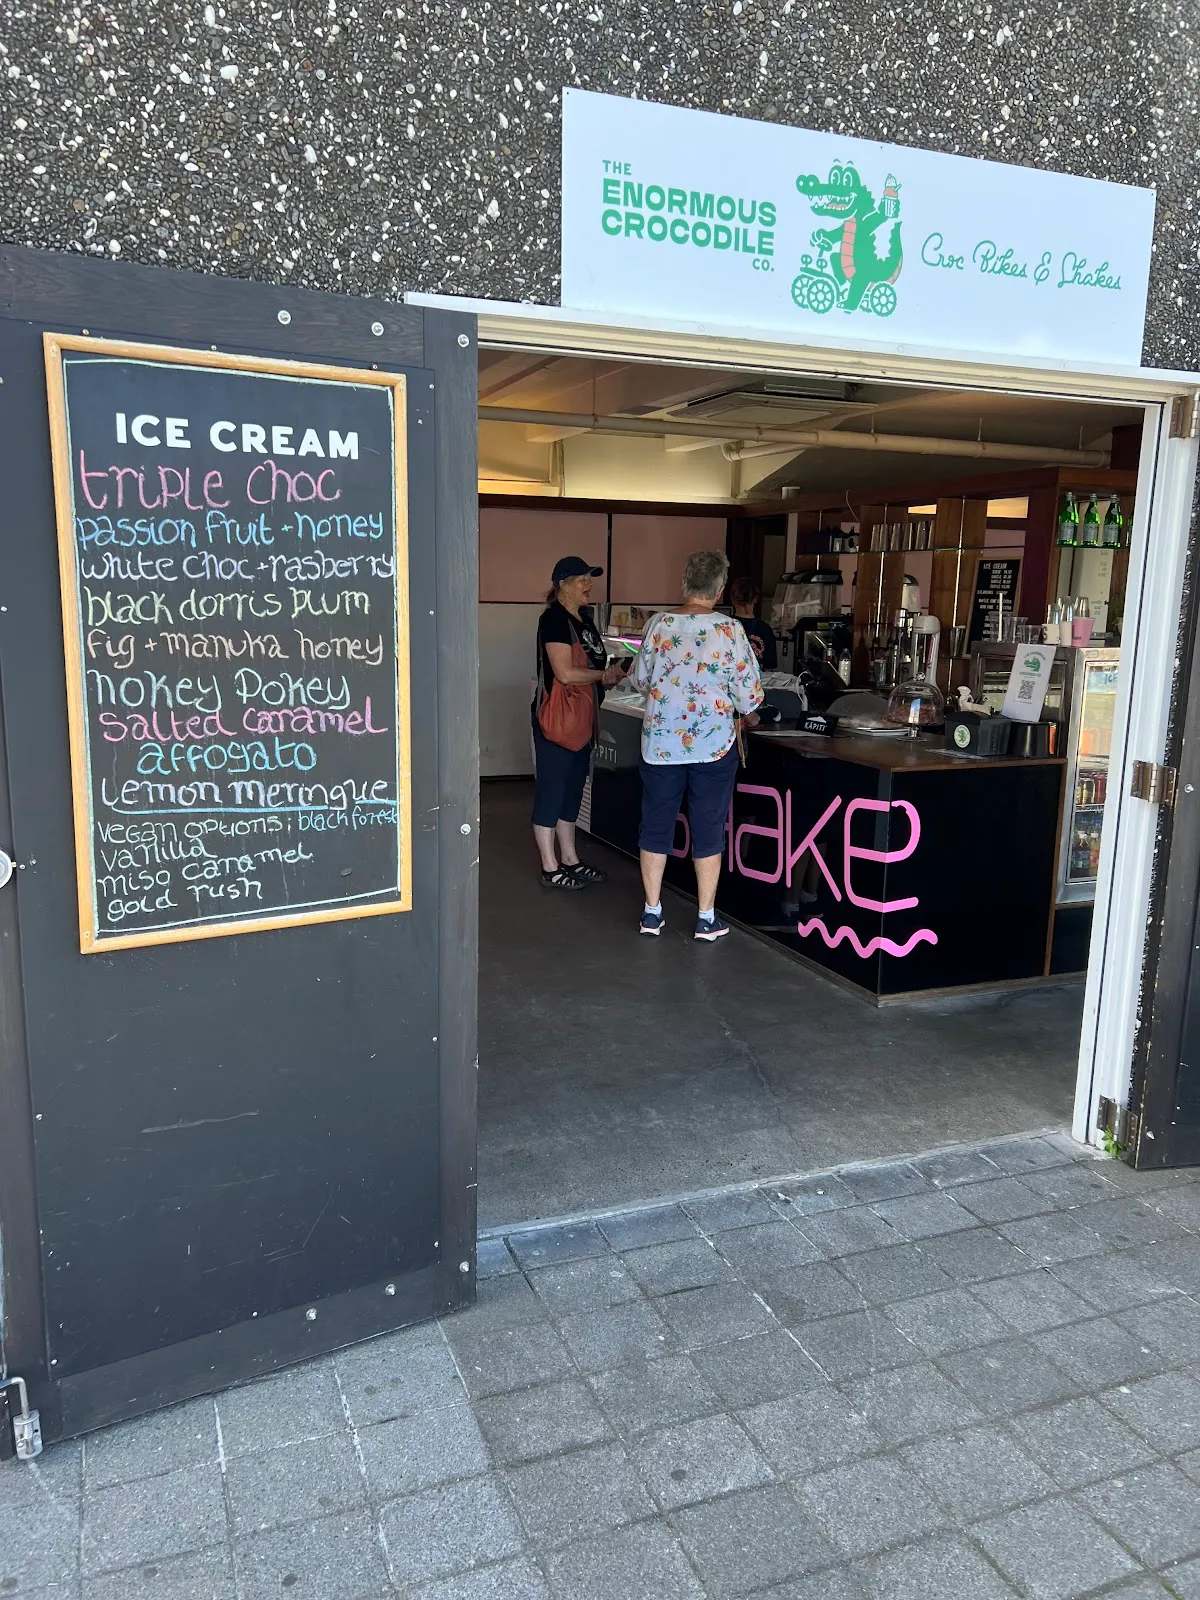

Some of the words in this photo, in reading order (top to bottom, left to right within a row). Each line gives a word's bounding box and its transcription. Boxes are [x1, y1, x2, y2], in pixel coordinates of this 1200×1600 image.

[602, 160, 632, 175] THE
[602, 178, 777, 227] ENORMOUS
[601, 209, 775, 256] CROCODILE
[752, 258, 775, 272] CO.
[921, 232, 964, 270] Croc
[972, 240, 1028, 278] Bikes
[1057, 251, 1121, 289] Shakes
[116, 412, 191, 449] ICE
[209, 420, 359, 460] CREAM
[76, 515, 196, 550] passion
[205, 510, 275, 546] fruit
[81, 551, 178, 581] white
[183, 550, 255, 581] choc
[83, 586, 174, 626] black
[86, 628, 135, 669] fig
[159, 630, 290, 660] manuka
[293, 628, 383, 665] honey
[243, 695, 389, 735] caramel
[136, 736, 318, 775] affogato
[227, 779, 389, 810] meringue
[298, 809, 350, 832] black
[97, 869, 171, 897] miso
[182, 842, 315, 882] caramel
[100, 839, 218, 872] vanilla
[107, 889, 178, 922] gold
[187, 878, 264, 902] rush
